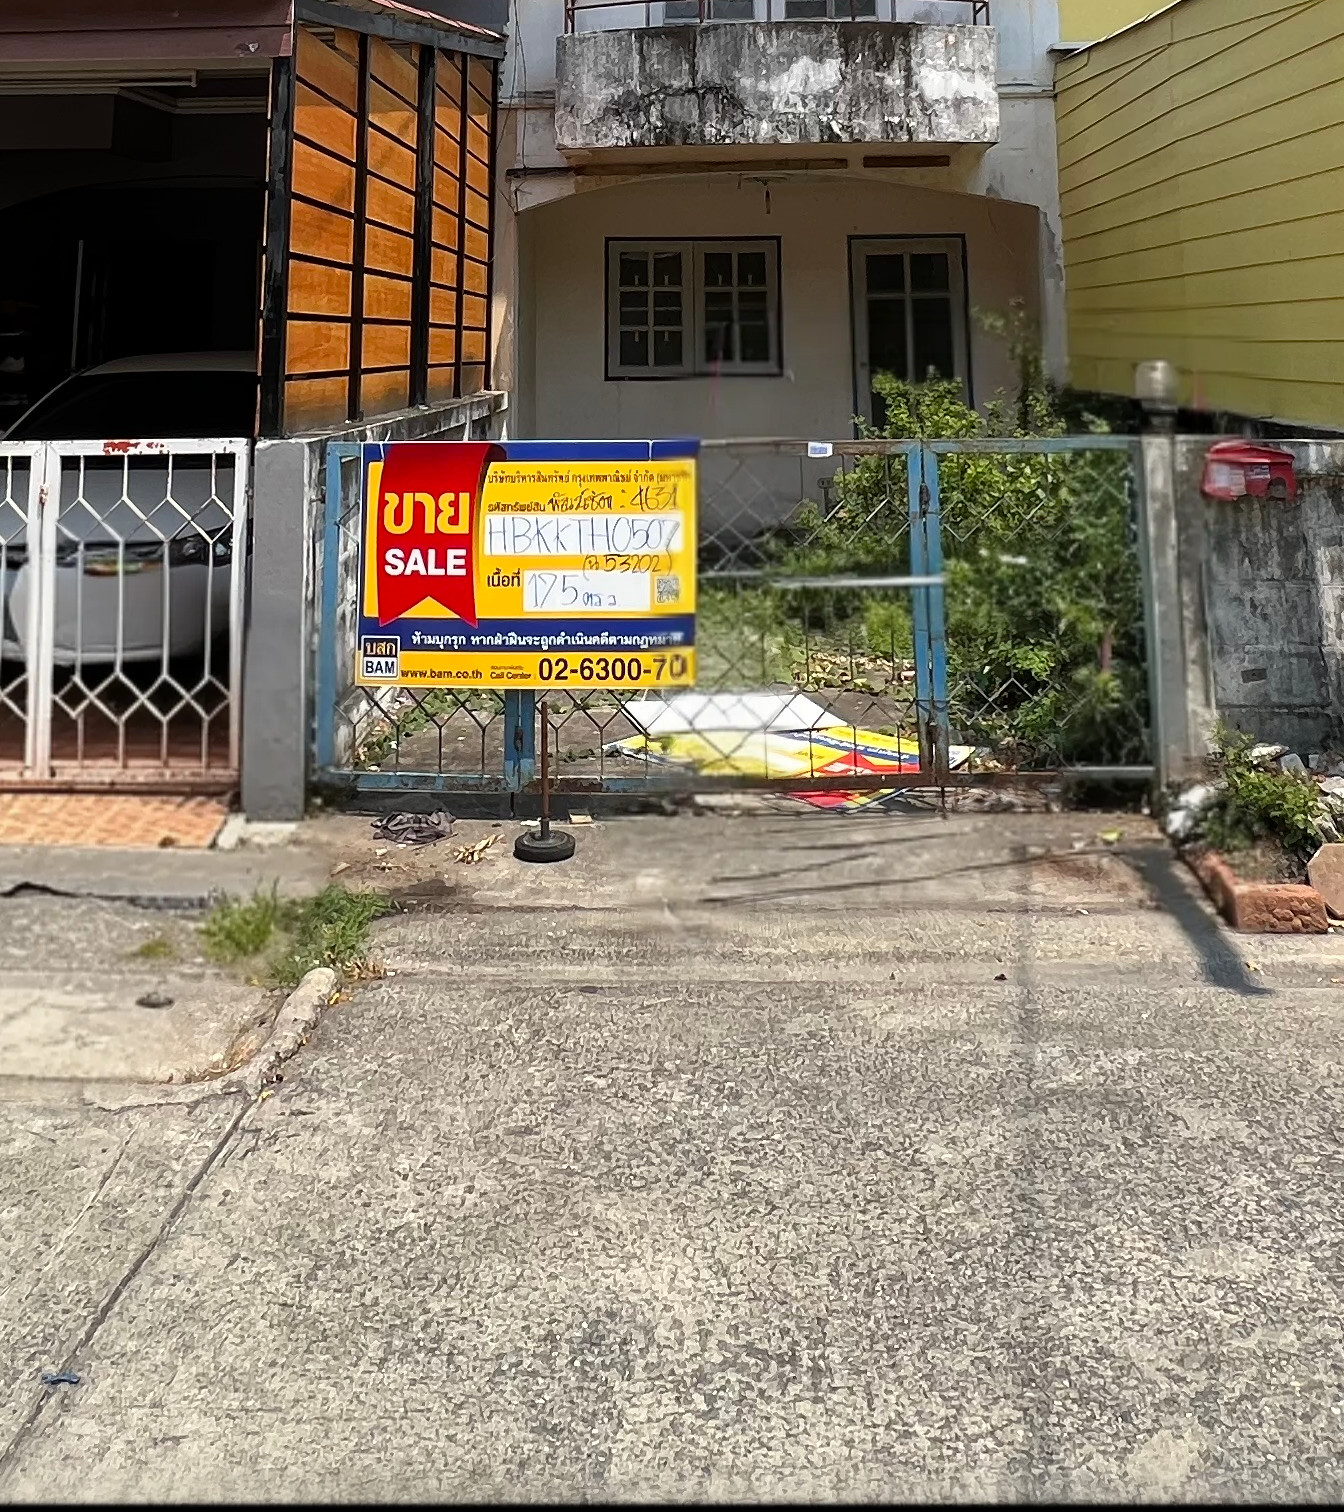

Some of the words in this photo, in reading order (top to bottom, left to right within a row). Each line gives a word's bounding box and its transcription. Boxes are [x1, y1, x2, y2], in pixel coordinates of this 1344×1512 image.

[488, 470, 570, 484] บริษัทบริหารสินทรัพย์
[634, 471, 654, 483] จำกัด
[383, 492, 470, 535] ขาย
[384, 548, 467, 576] SALE
[487, 568, 521, 587] เนื้อที่
[411, 631, 466, 650] ห้ามบุกรุก
[365, 642, 396, 656] บสก
[365, 661, 395, 674] BAM
[401, 668, 483, 680] www.bam.co.th
